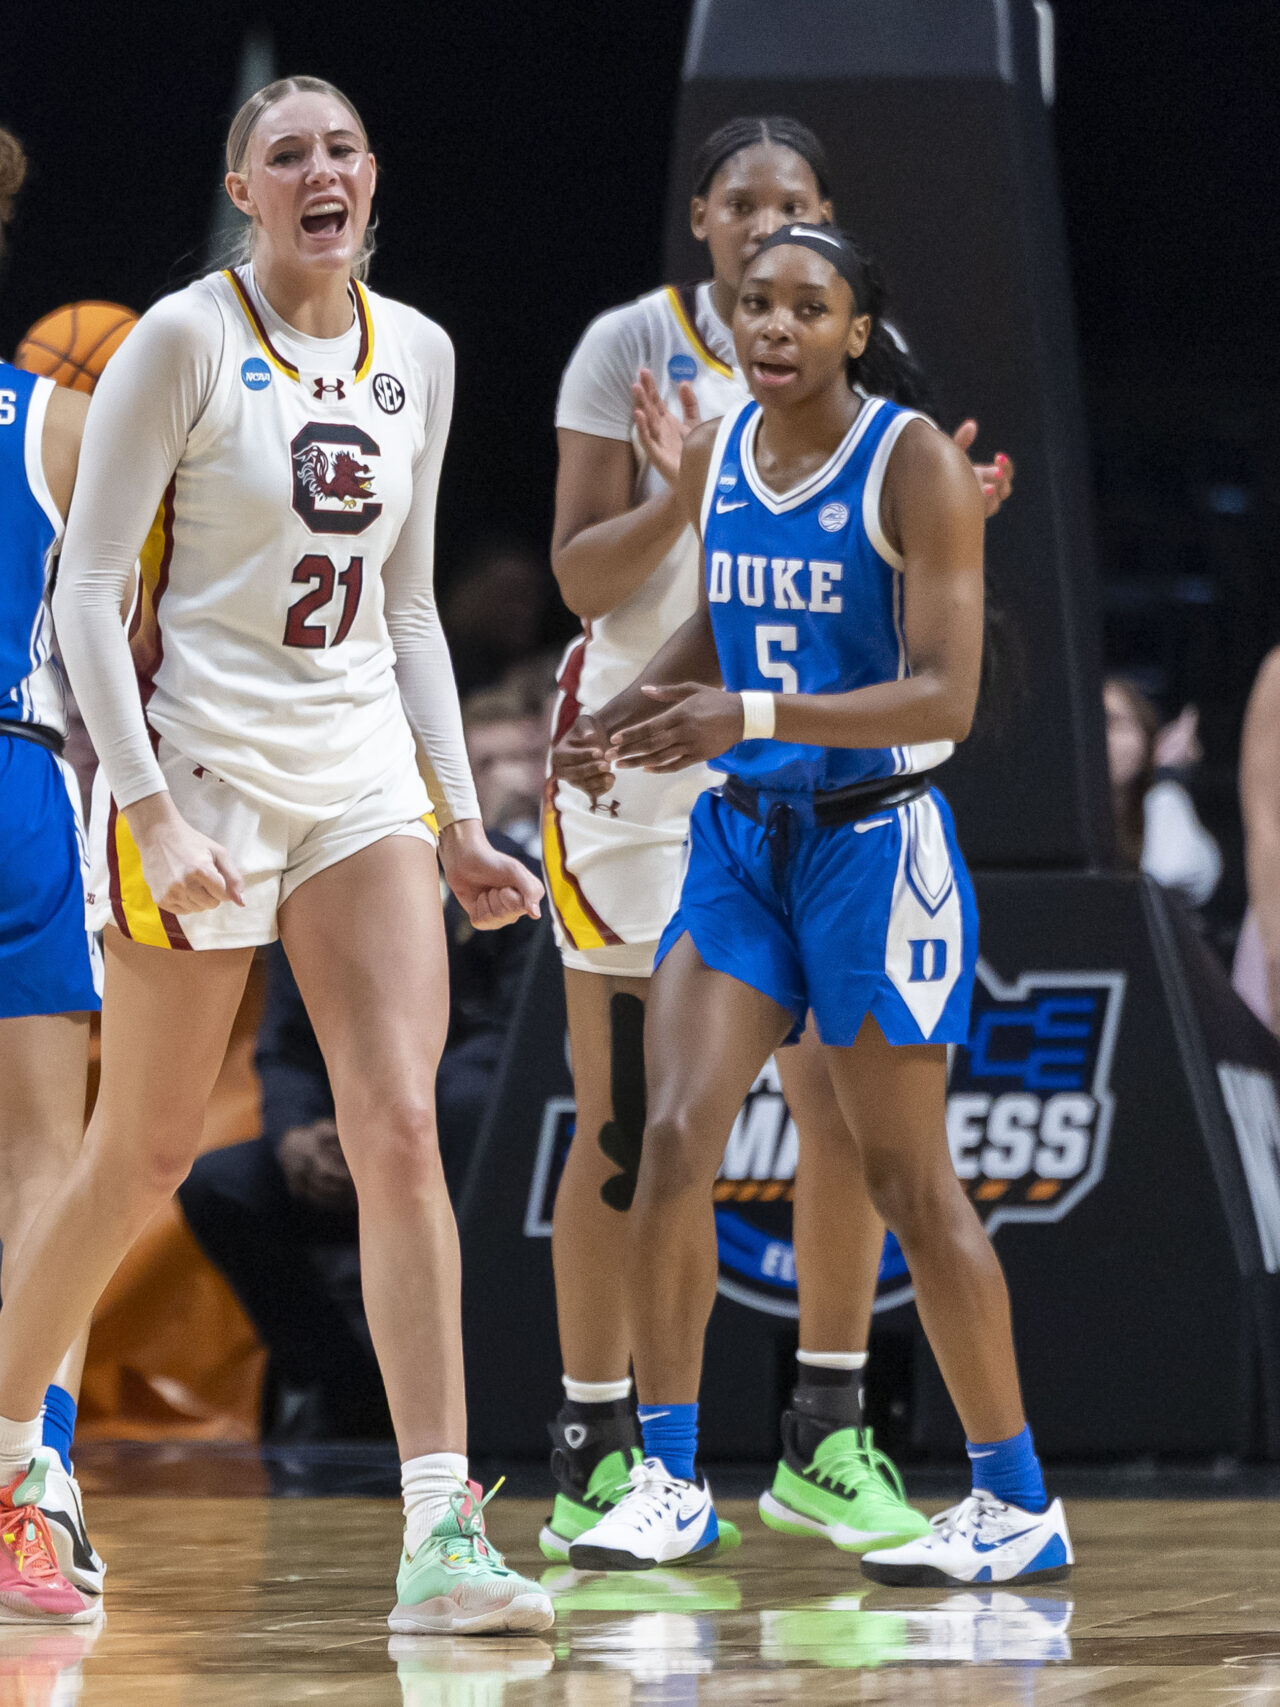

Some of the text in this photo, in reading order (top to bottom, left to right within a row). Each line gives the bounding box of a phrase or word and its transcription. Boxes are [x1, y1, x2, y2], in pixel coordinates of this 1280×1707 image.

[245, 371, 271, 382] NCAA
[374, 374, 403, 412] SEC
[282, 554, 364, 649] 21
[708, 551, 844, 614] DUKE
[755, 625, 799, 694] 5
[908, 938, 947, 983] D
